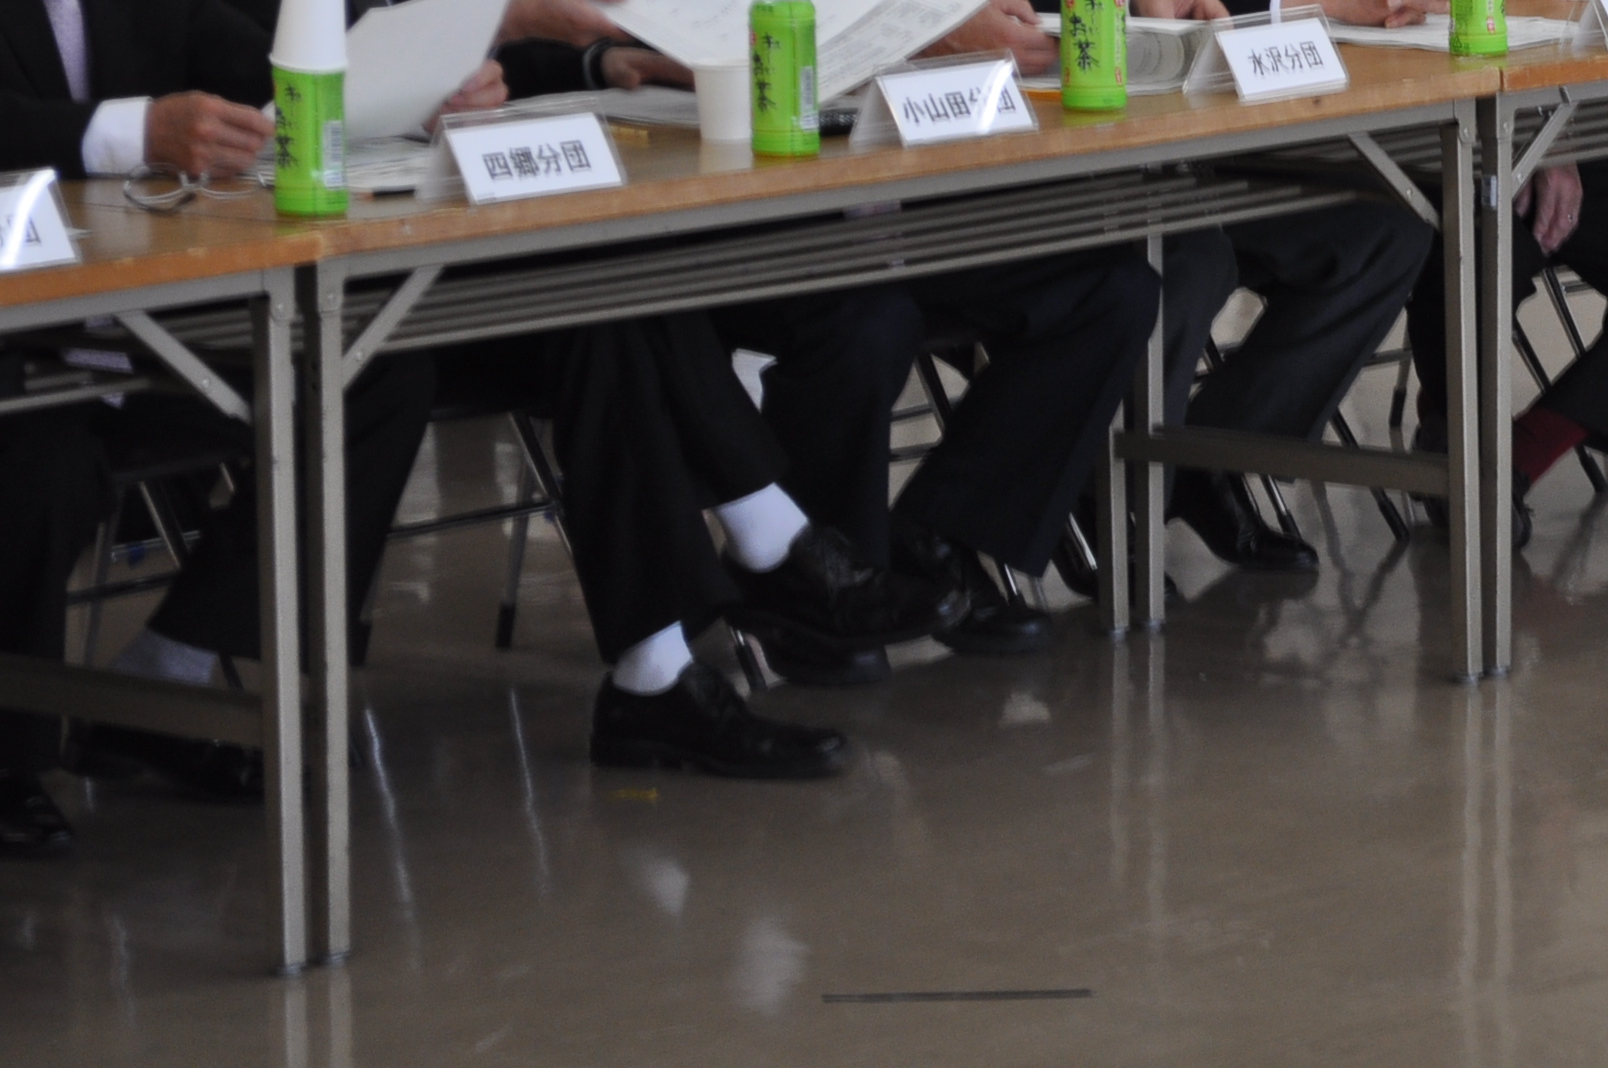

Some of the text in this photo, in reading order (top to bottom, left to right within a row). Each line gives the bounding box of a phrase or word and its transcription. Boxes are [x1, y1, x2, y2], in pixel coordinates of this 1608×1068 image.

[1248, 40, 1324, 76] 水沢分団
[482, 139, 592, 180] 四郷分団
